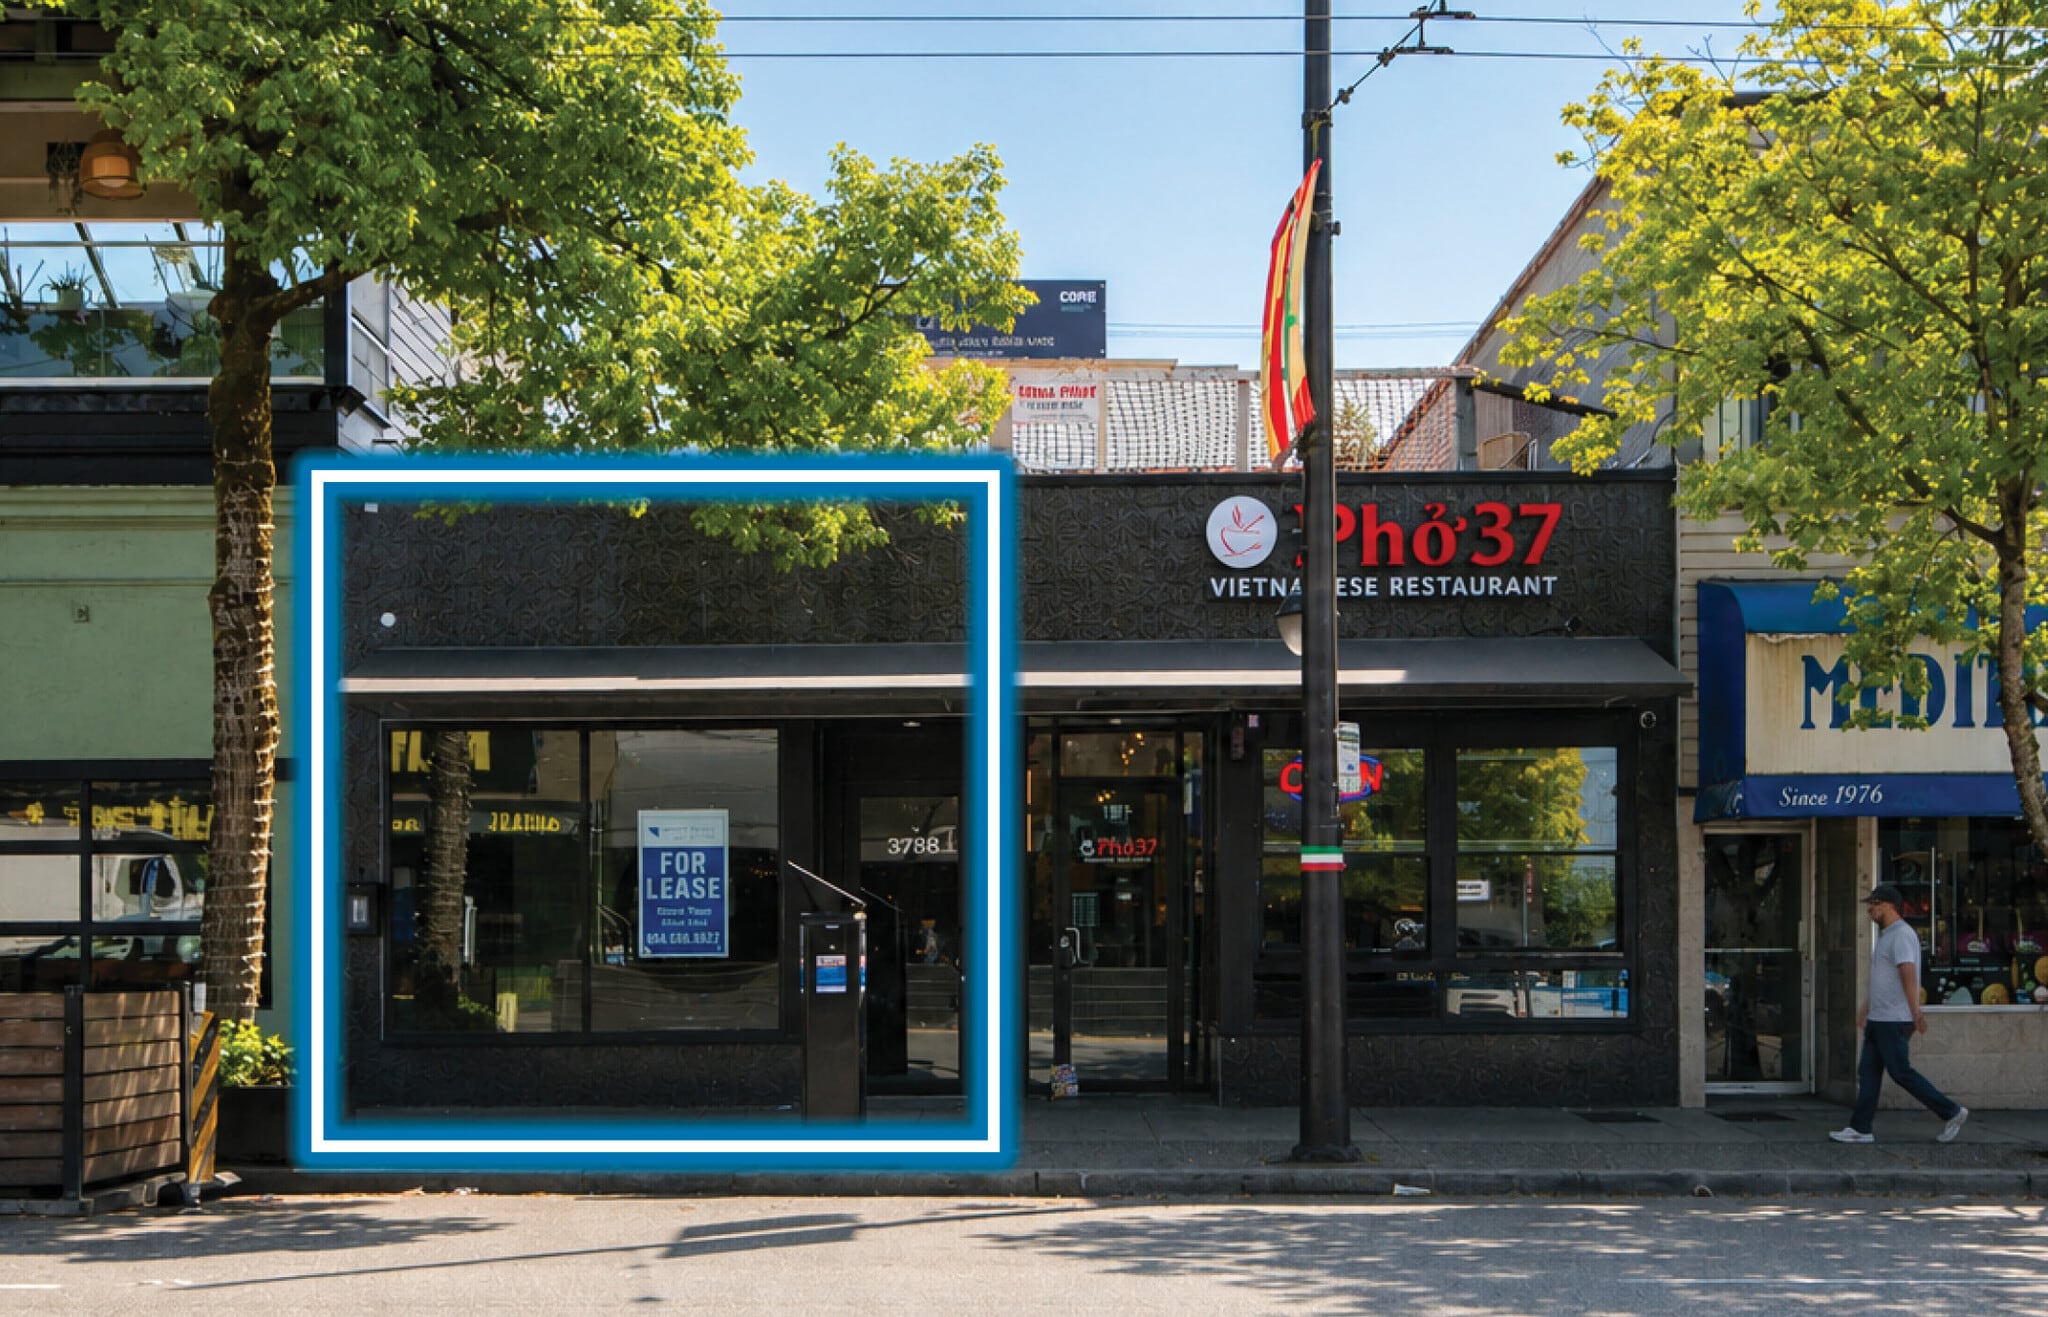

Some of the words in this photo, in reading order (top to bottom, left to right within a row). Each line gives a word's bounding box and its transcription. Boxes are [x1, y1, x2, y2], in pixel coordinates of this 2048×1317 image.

[1210, 575, 1379, 597] VIETNAESE
[1390, 575, 1558, 597] RESTAURANT
[1778, 785, 1829, 808] Since
[1834, 783, 1884, 804] 1976
[887, 836, 941, 855] 3788
[660, 851, 707, 875] FOR
[646, 877, 721, 900] LEASE
